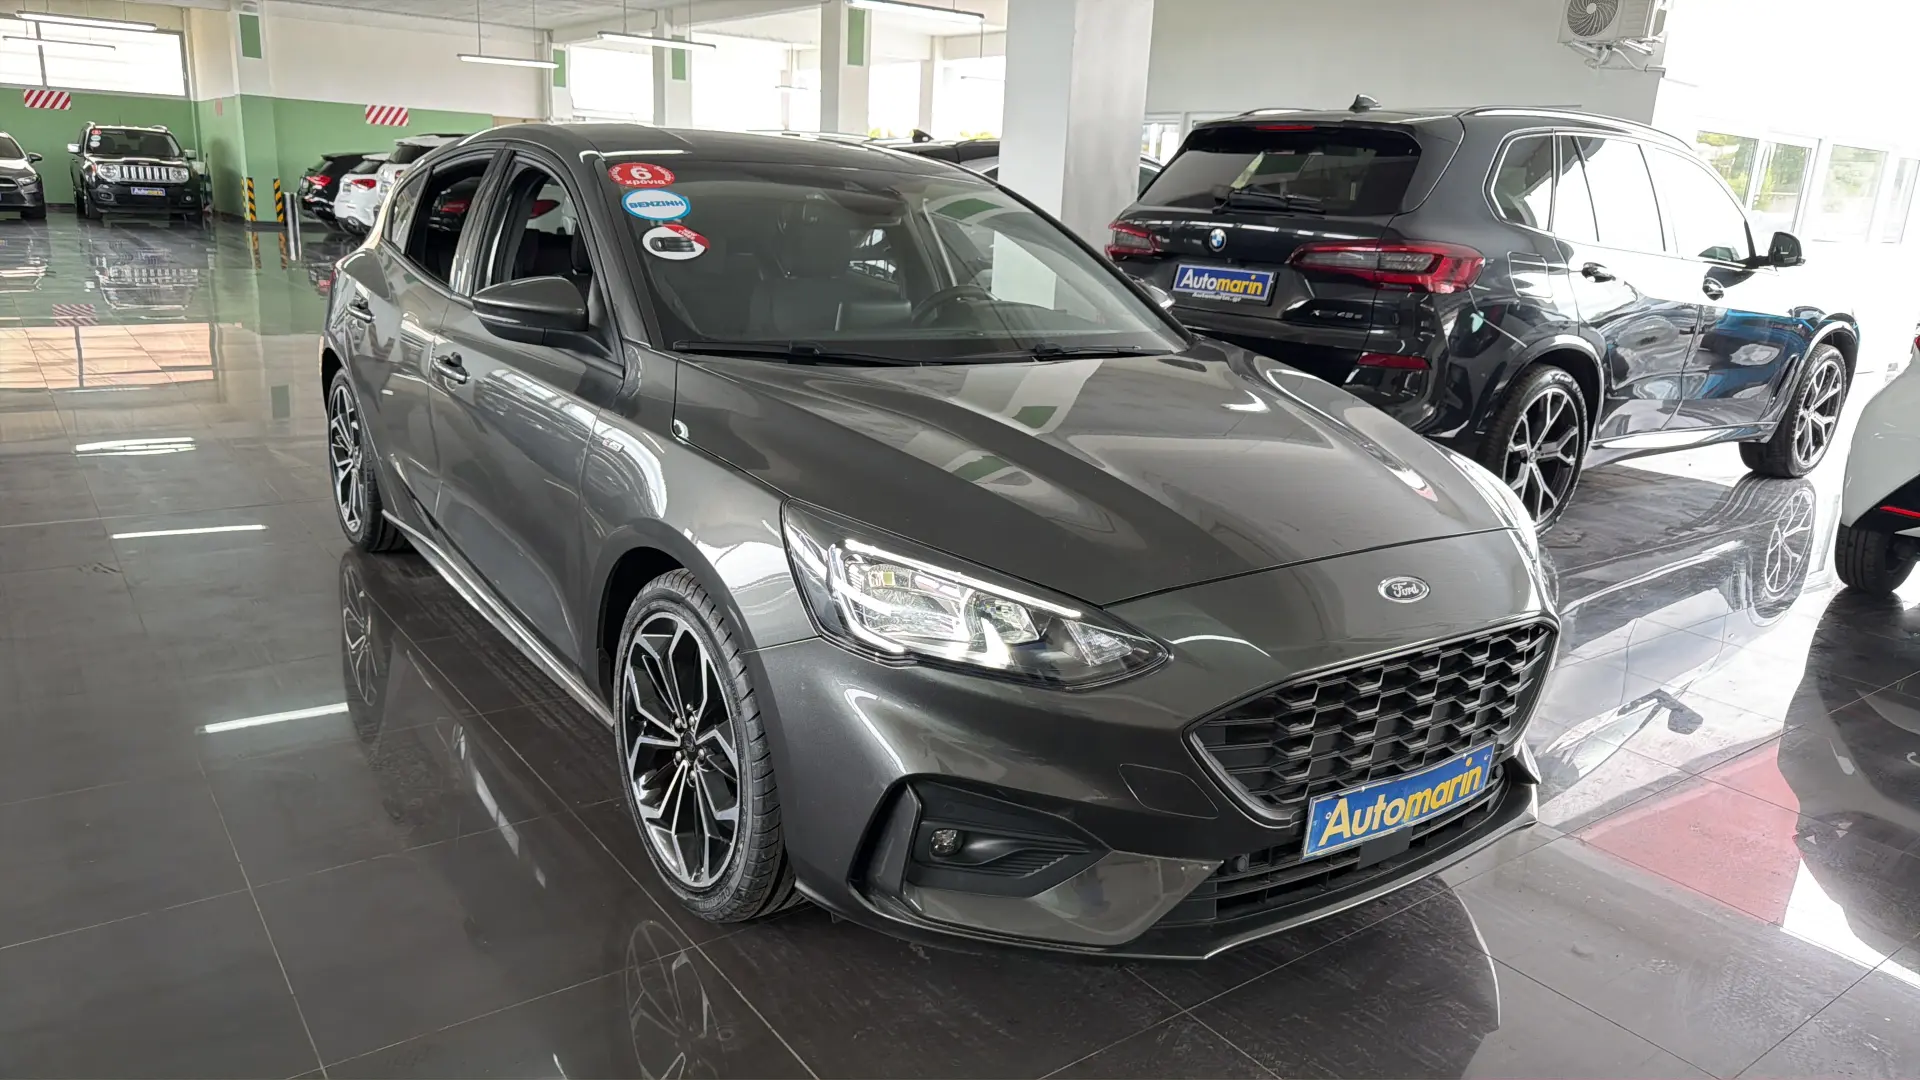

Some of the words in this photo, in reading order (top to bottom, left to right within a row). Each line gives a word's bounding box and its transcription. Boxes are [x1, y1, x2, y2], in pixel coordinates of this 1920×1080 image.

[1180, 268, 1262, 296] Automarin
[1391, 582, 1419, 597] Ford
[1318, 757, 1482, 847] Automarin
